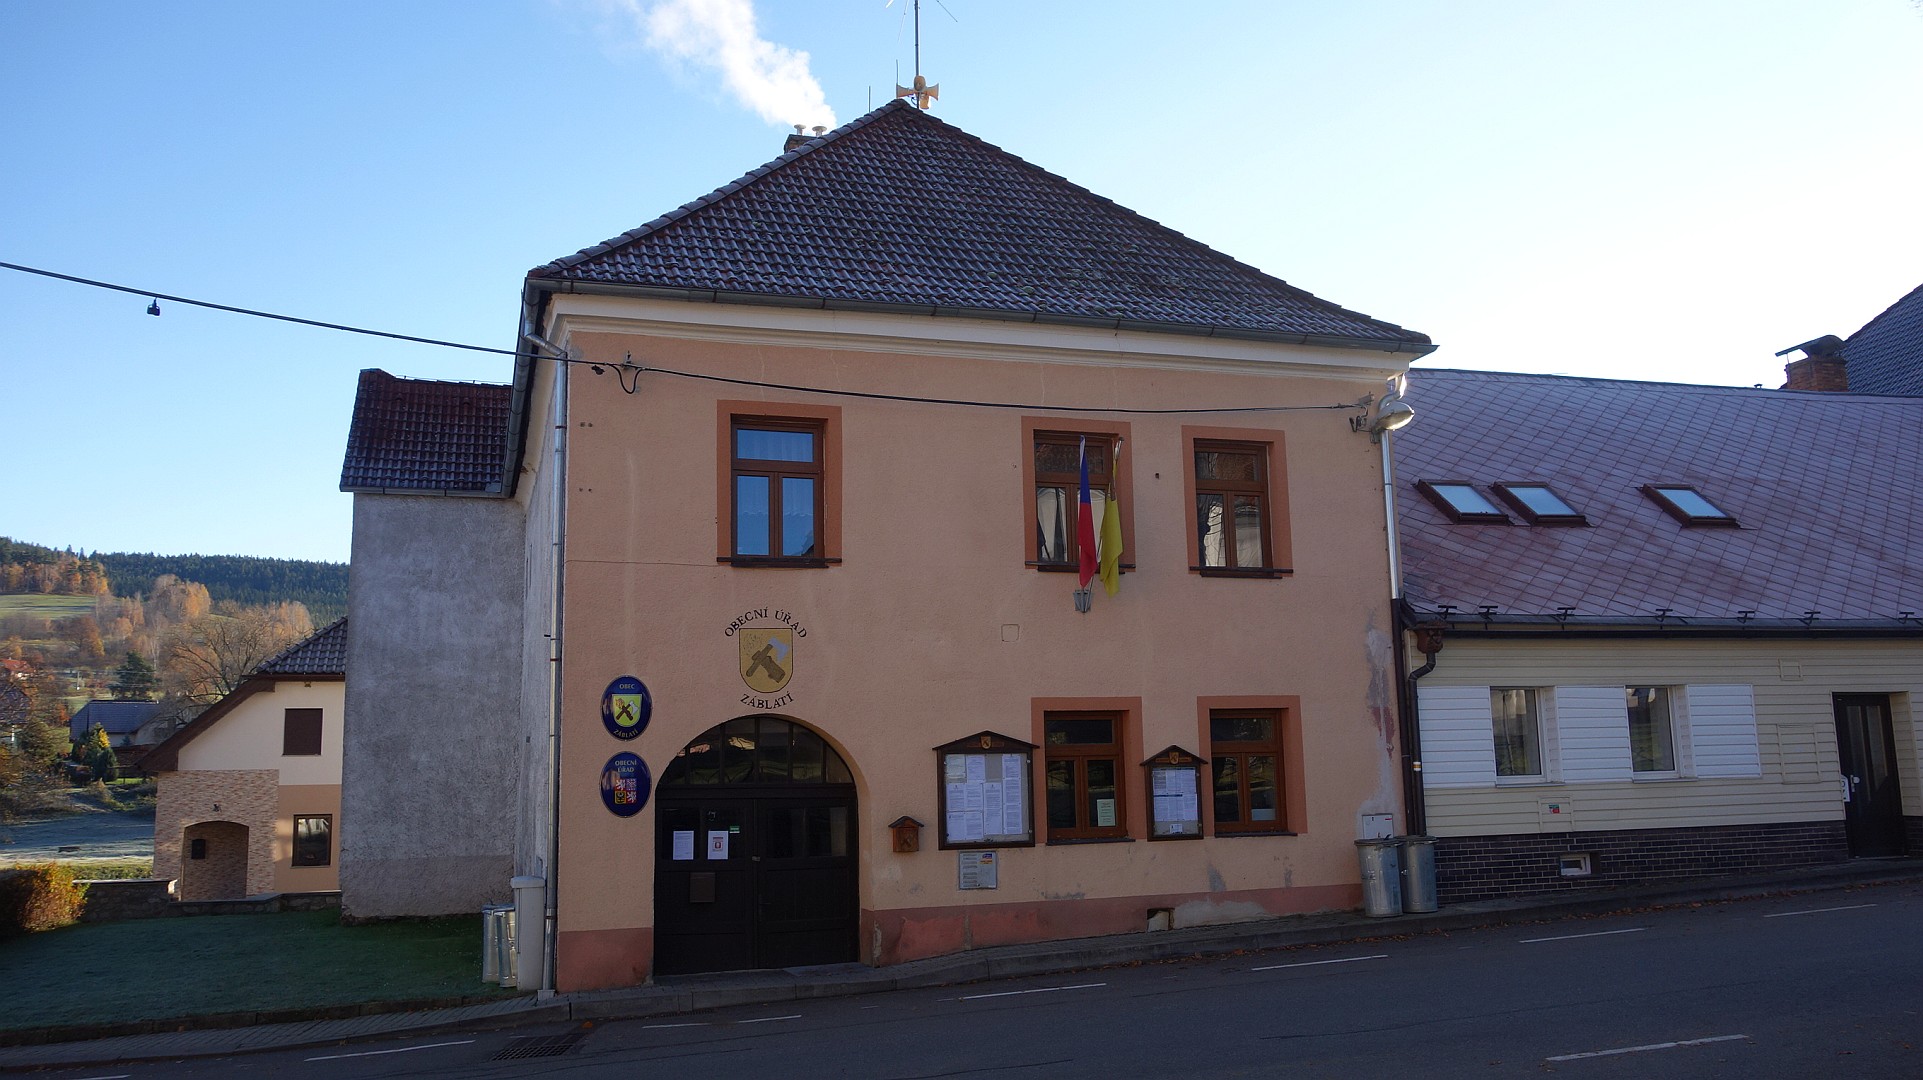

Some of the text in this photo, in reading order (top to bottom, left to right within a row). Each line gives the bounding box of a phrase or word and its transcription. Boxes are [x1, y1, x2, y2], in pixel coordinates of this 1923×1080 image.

[724, 607, 807, 638] OBECNÍ ÚŘAD
[740, 691, 794, 709] ZÁBLATÍ
